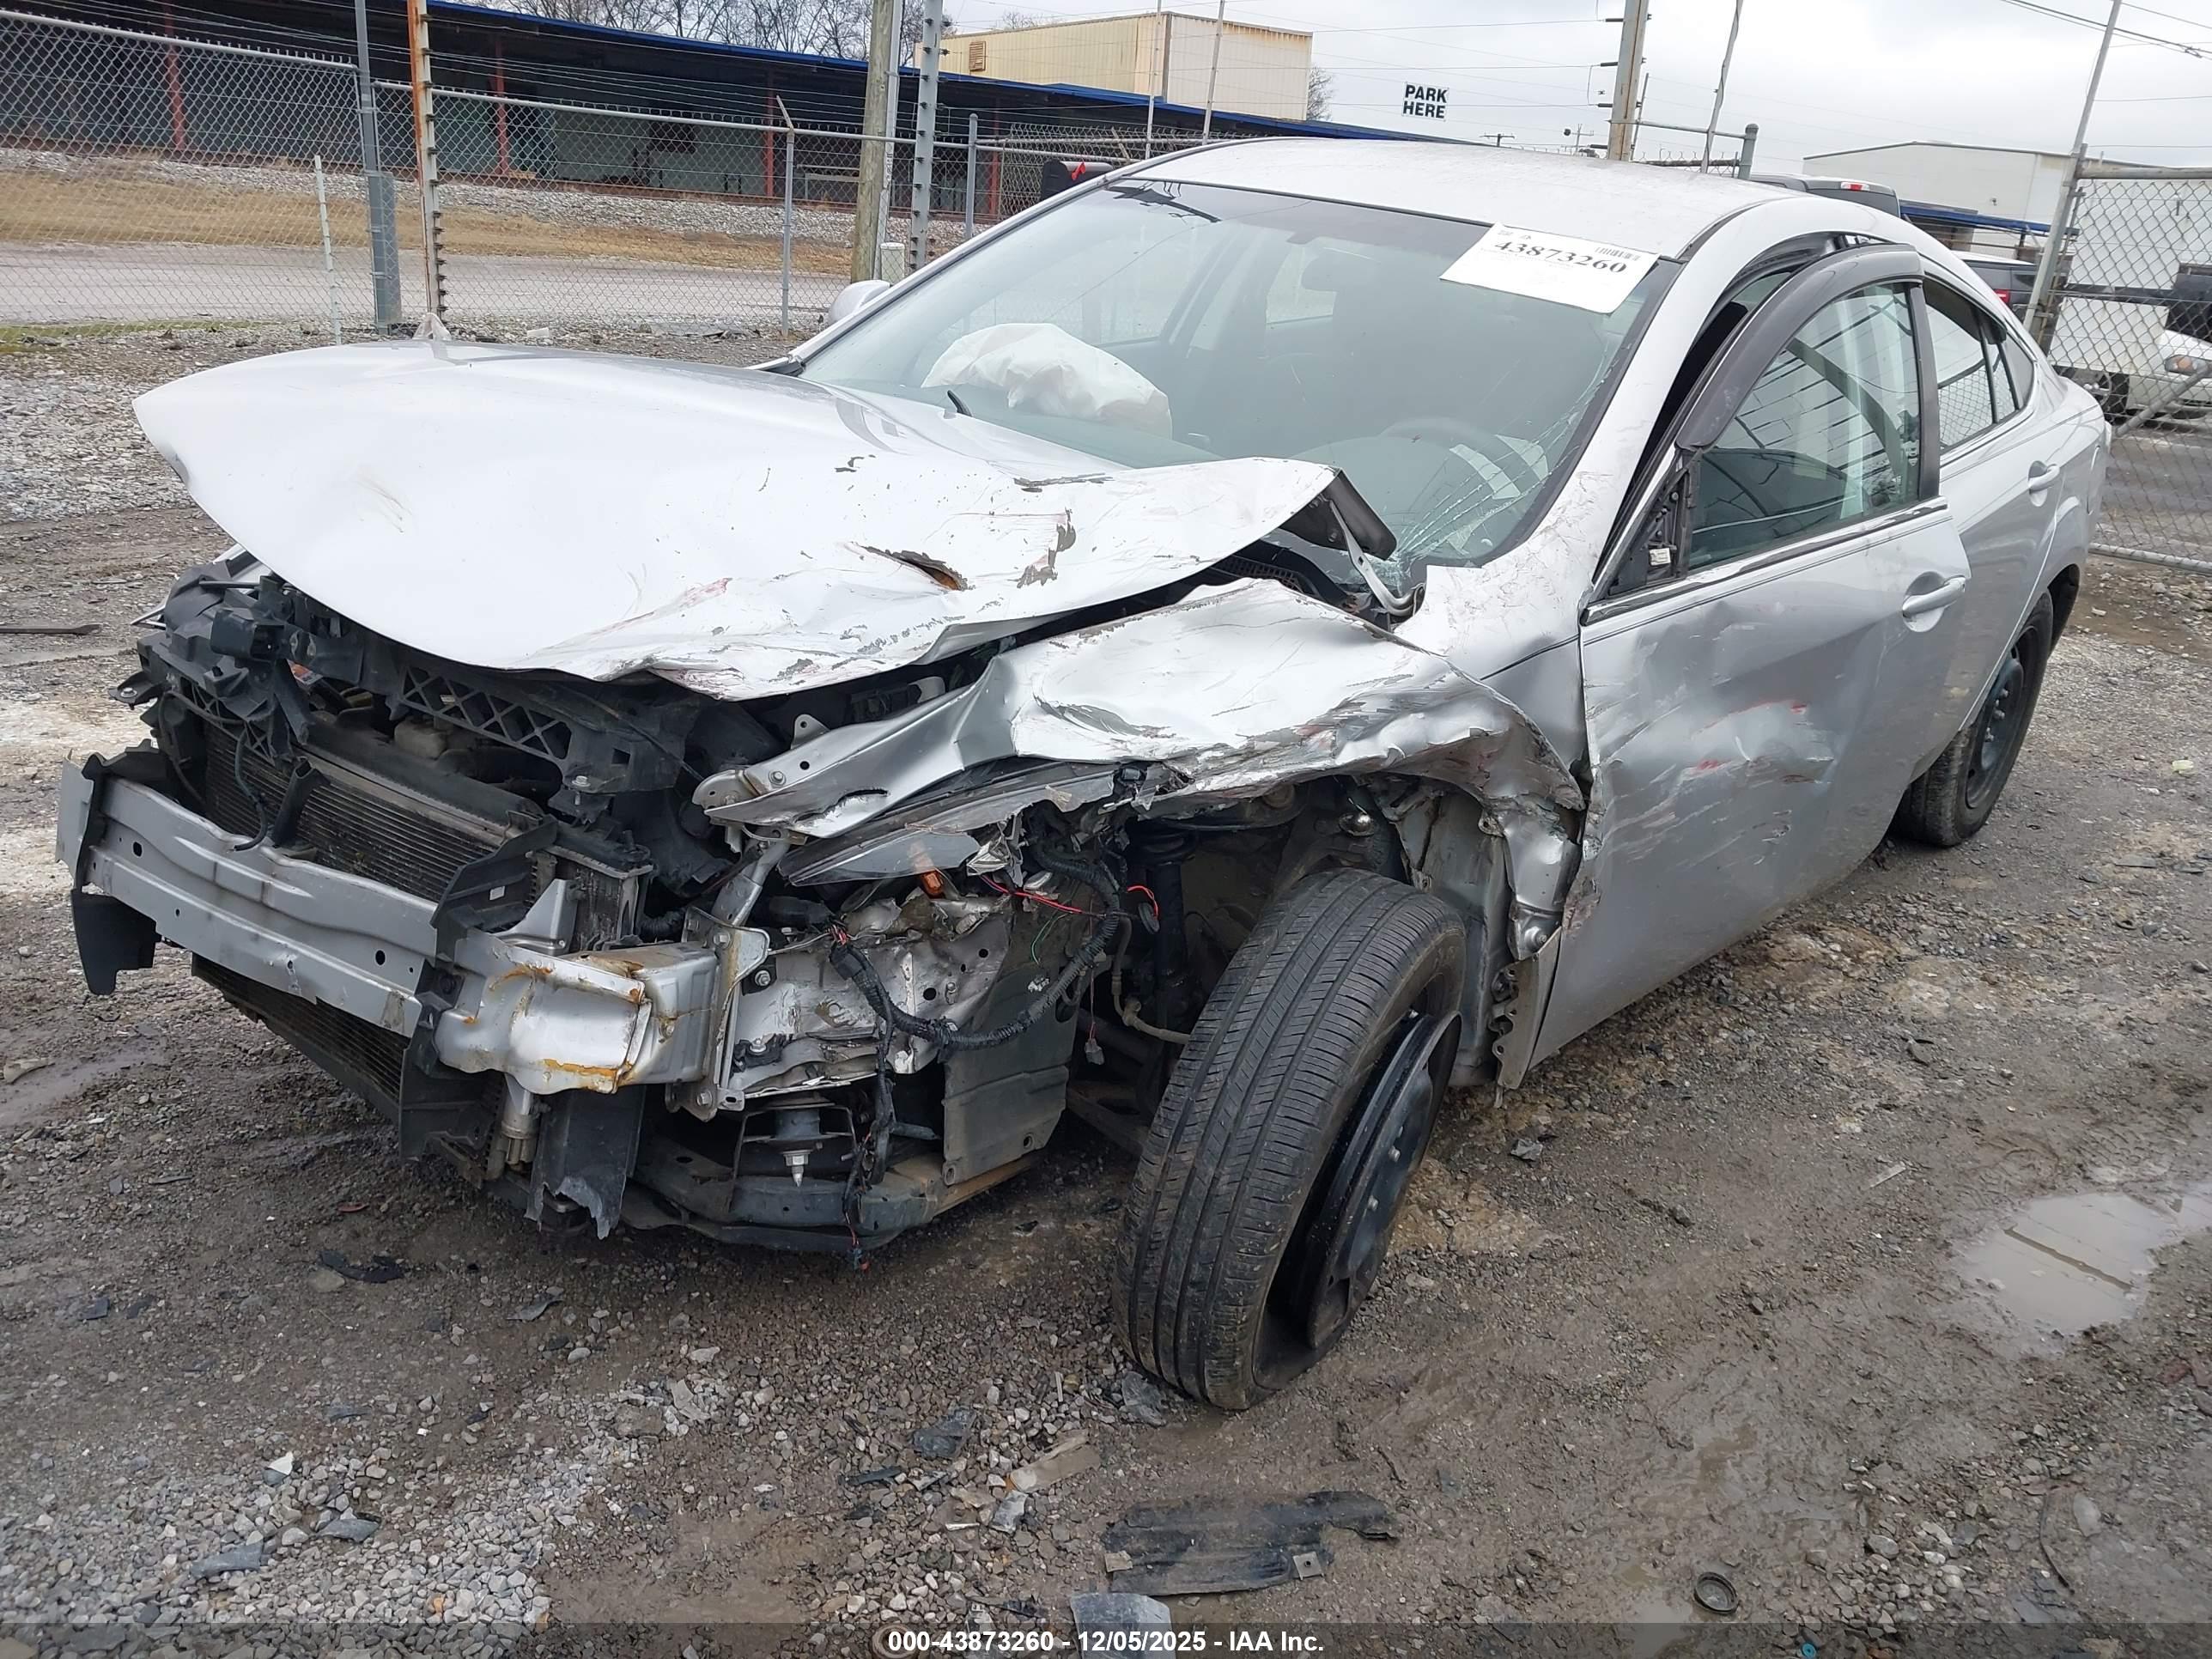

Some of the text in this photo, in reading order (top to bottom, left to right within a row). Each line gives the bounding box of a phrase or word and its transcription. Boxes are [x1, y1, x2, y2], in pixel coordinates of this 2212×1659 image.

[1405, 84, 1448, 103] PARK
[1402, 100, 1446, 118] HERE
[1494, 241, 1627, 273] 43873260
